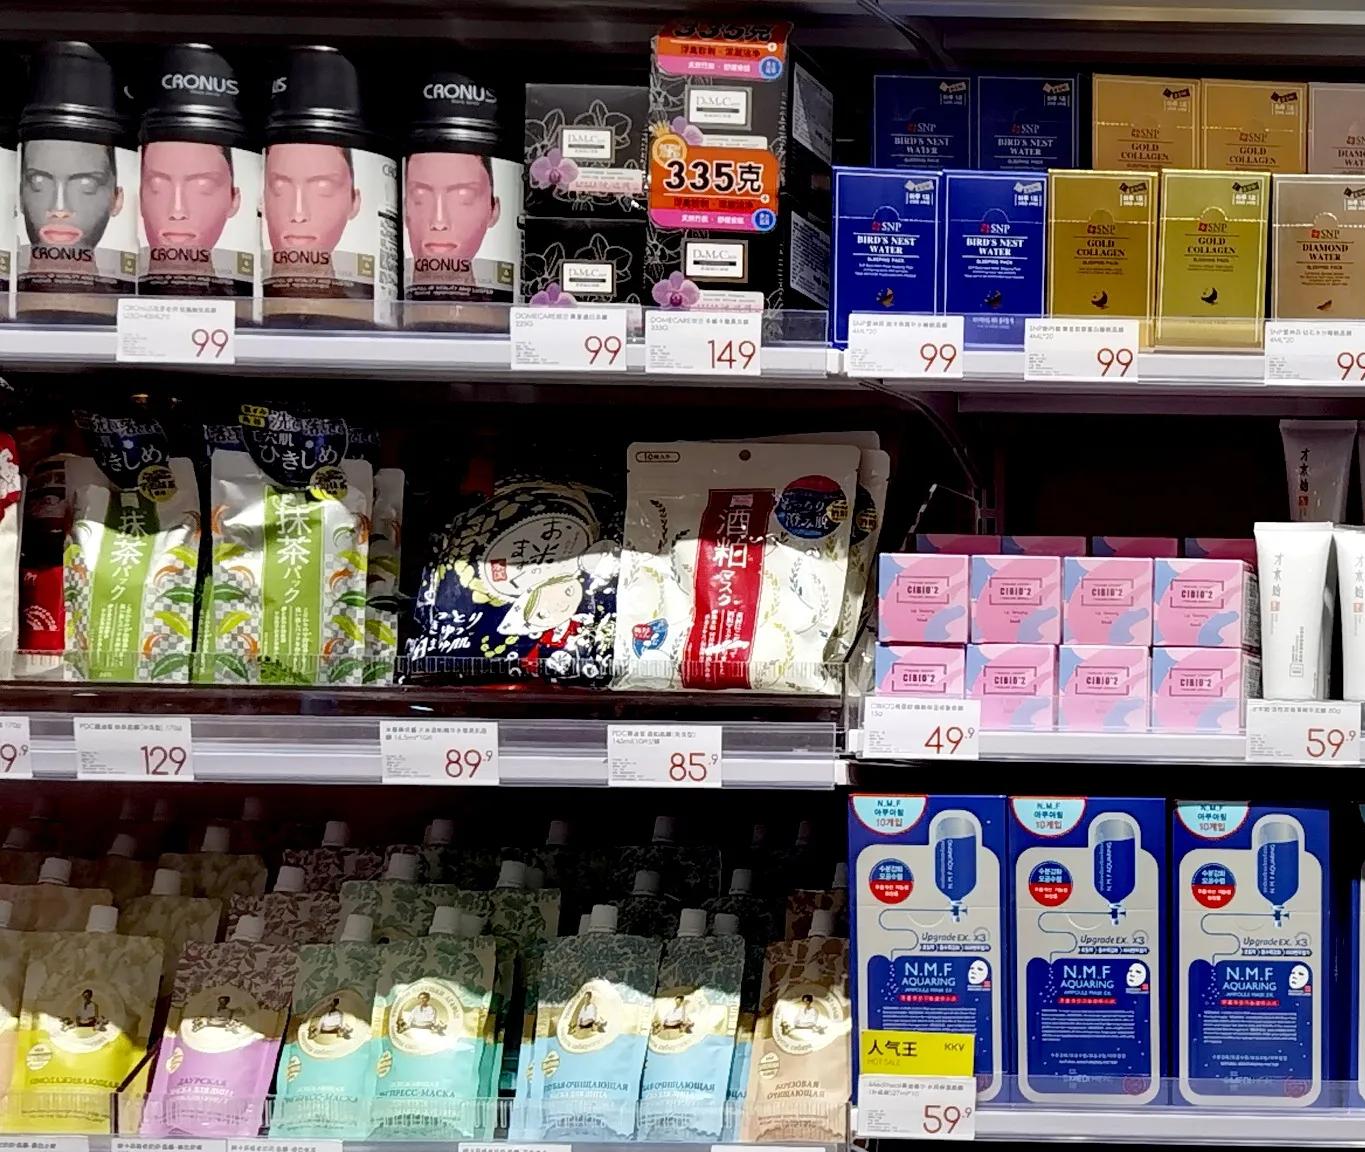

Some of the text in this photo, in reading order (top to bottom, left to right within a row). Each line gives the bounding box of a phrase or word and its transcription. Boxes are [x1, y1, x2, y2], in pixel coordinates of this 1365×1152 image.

[162, 74, 239, 95] CRONUS
[664, 156, 765, 196] 335克
[870, 246, 902, 255] WATER
[1088, 240, 1115, 249] GOLD
[1302, 243, 1348, 253] DIAMOND
[32, 247, 91, 262] CRONUS
[192, 329, 228, 359] 99
[707, 340, 756, 369] 149
[919, 343, 956, 373] 99
[140, 744, 186, 776] 129
[904, 962, 952, 977] N.M.F
[901, 978, 955, 987] AQUARING
[867, 1040, 917, 1057] 人气王
[944, 1043, 964, 1052] KKV
